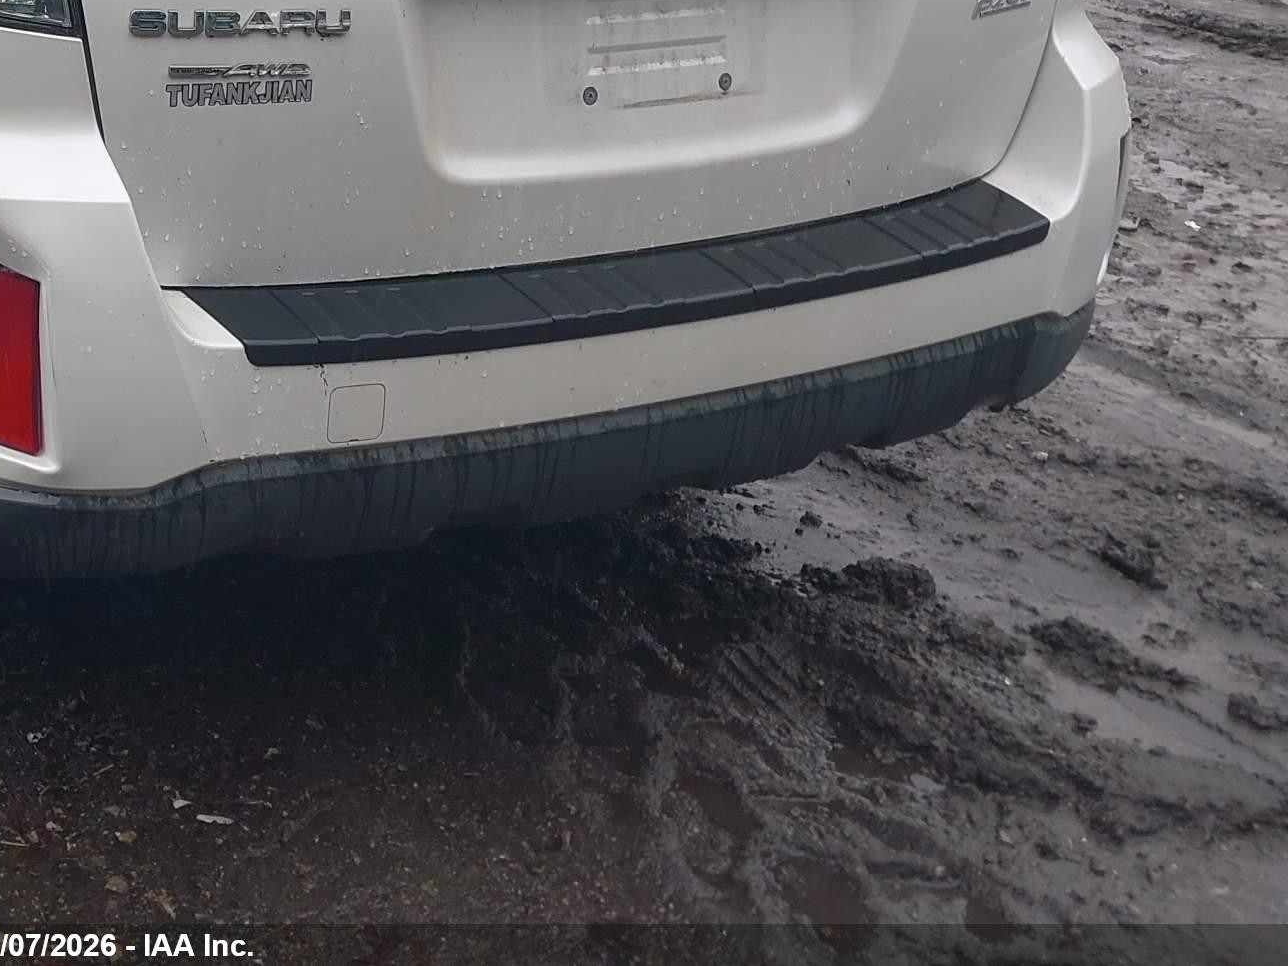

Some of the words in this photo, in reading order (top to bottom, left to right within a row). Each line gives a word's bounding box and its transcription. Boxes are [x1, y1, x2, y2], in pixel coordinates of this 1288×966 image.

[129, 9, 352, 37] SUBARU
[223, 63, 313, 78] AWD
[165, 79, 313, 108] TUFANKJIAN
